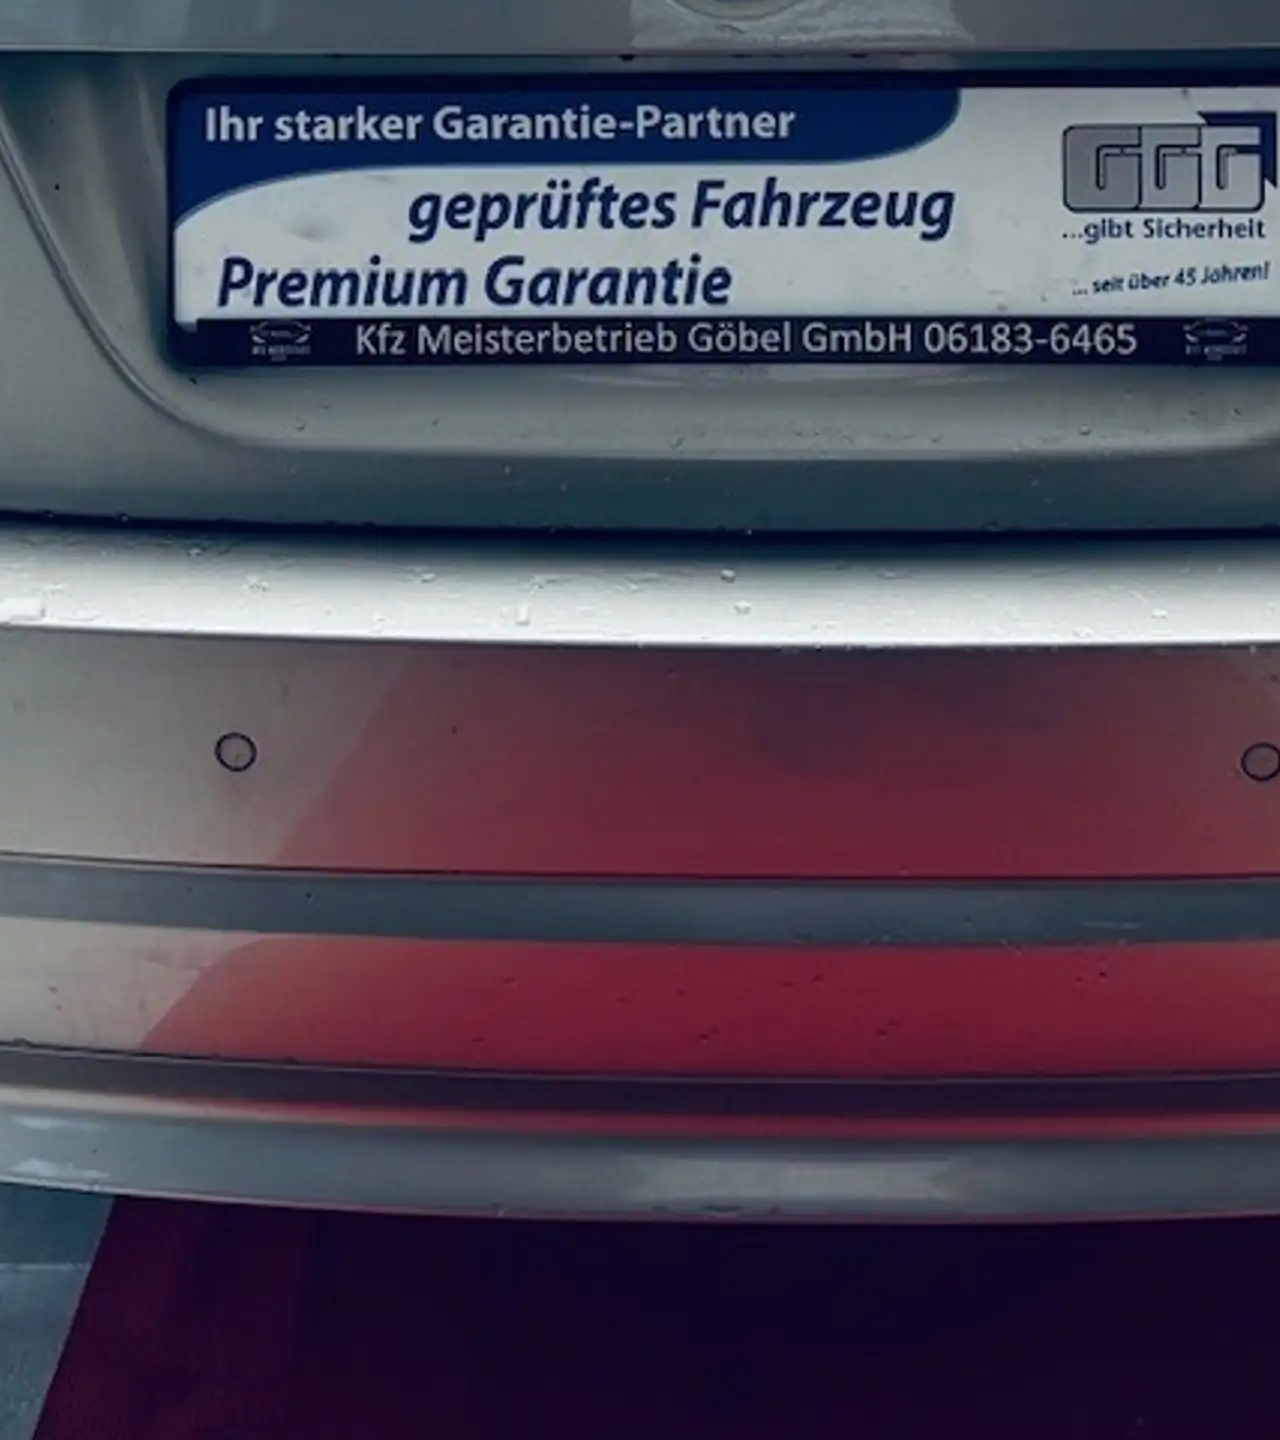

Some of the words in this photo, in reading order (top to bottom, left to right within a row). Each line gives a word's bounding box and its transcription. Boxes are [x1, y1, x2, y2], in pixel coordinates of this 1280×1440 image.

[206, 105, 263, 141] Ihr
[274, 105, 424, 141] starker
[433, 104, 796, 140] Garantie-Partner
[408, 177, 677, 242] geprüftes
[692, 176, 956, 242] Fahrzeug
[1143, 218, 1266, 239] Sicherheit
[218, 255, 468, 308] Premium
[486, 253, 732, 307] Garantie
[1092, 277, 1124, 295] seit
[1127, 271, 1171, 291] über
[1173, 266, 1197, 287] 45
[356, 322, 406, 355] Kfz
[418, 322, 677, 355] Meisterbetrieb
[688, 321, 791, 353] Göbel
[802, 321, 912, 353] GmbH
[923, 321, 1137, 355] 06183-6465
